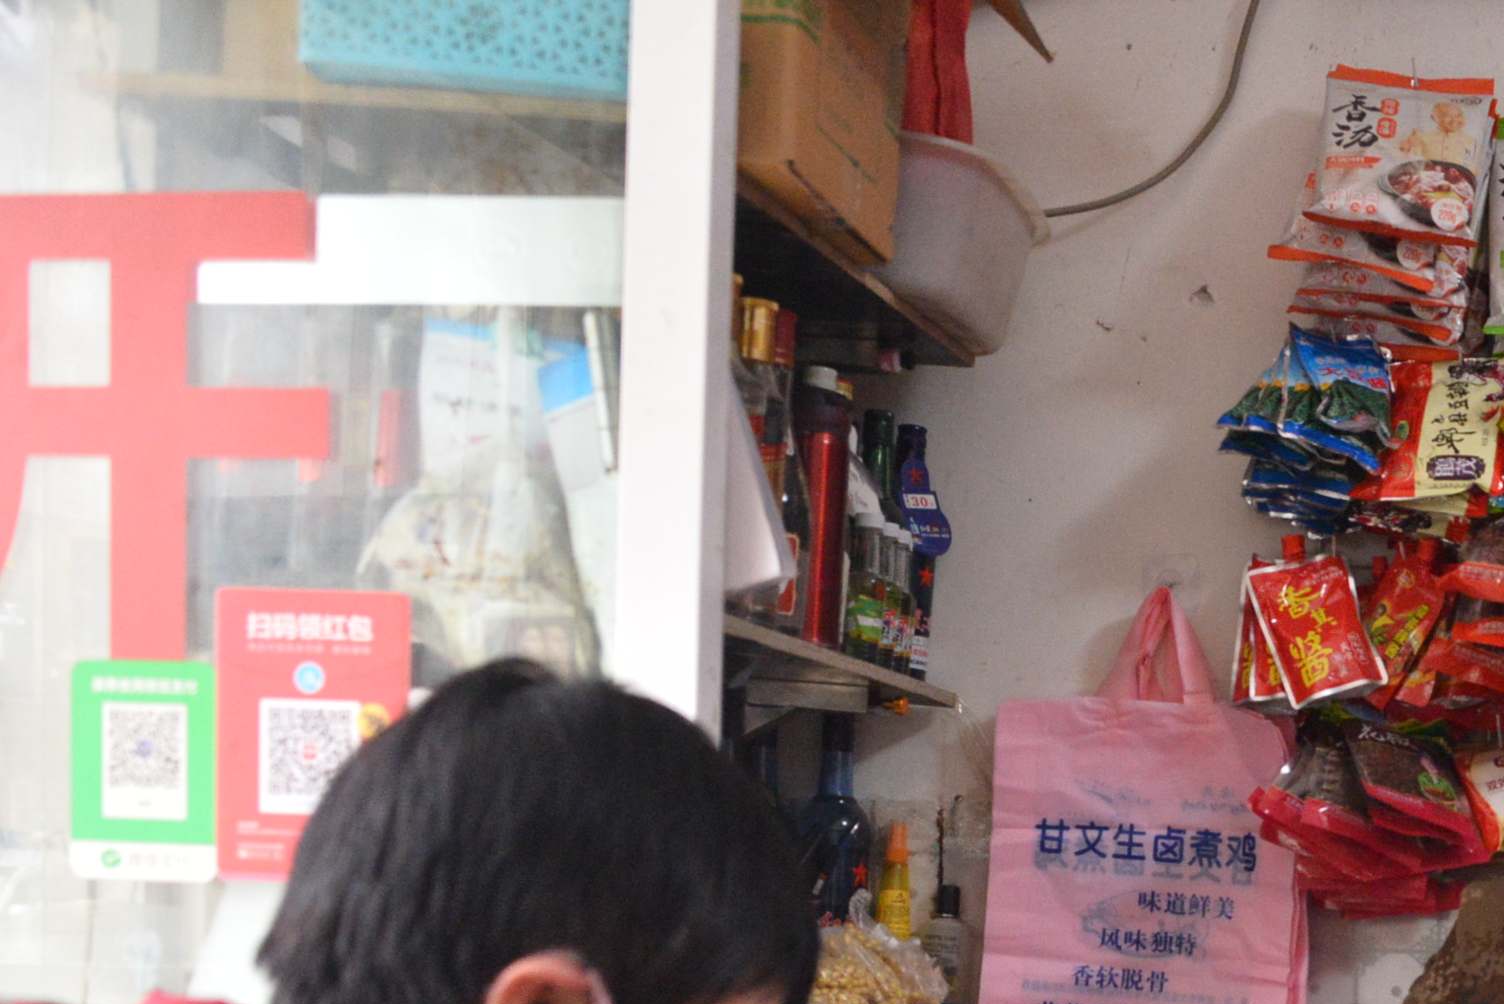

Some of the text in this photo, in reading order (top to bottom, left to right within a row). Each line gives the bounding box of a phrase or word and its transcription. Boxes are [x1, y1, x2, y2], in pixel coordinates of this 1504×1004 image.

[1332, 94, 1380, 149] 香汤
[247, 612, 374, 642] 扫码领红包
[1035, 817, 1258, 872] 甘文生卤煮鸡
[1137, 889, 1236, 921] 味道鲜美
[1099, 927, 1199, 956] 风味独特
[1072, 964, 1169, 993] 香软脱骨
